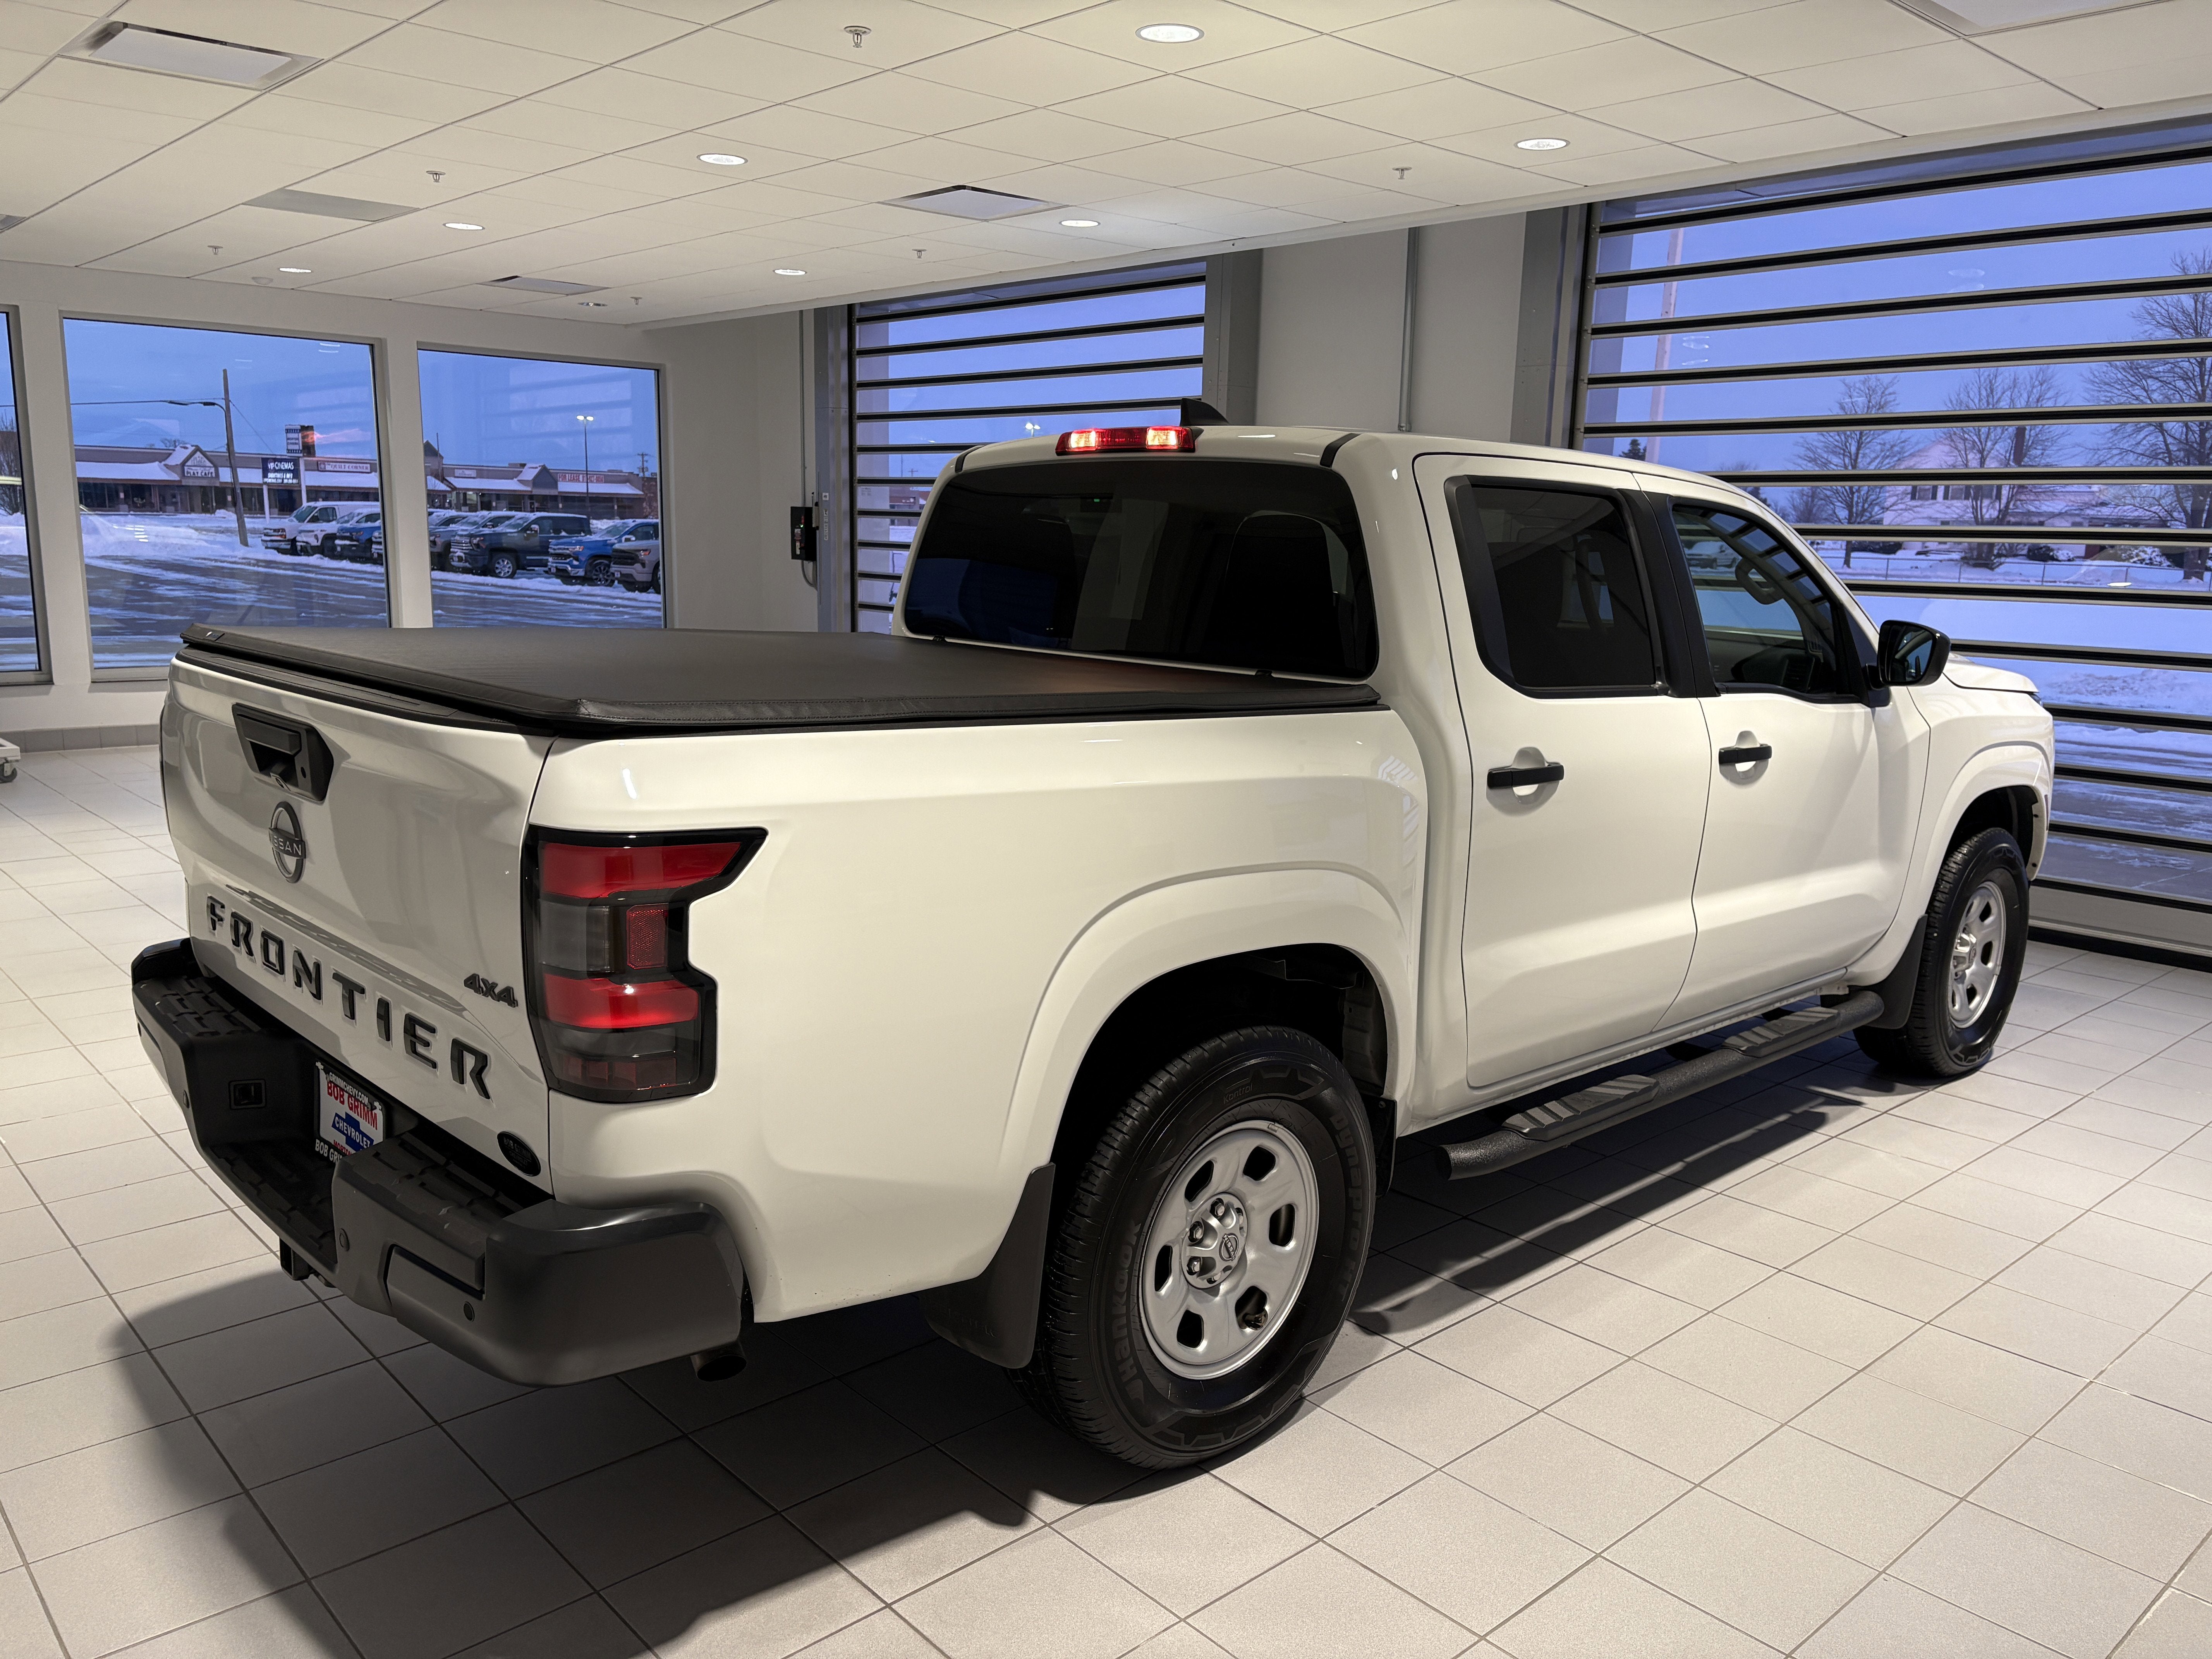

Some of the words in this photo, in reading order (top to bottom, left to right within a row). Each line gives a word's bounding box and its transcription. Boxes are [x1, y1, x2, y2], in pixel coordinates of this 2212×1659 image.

[206, 895, 491, 1100] FRONTIER
[327, 1081, 345, 1105] BOB
[347, 1094, 378, 1130] GRIMM
[1223, 1084, 1253, 1104] Kontrol
[315, 1139, 328, 1157] BOB
[335, 1116, 370, 1149] CHEVROLET
